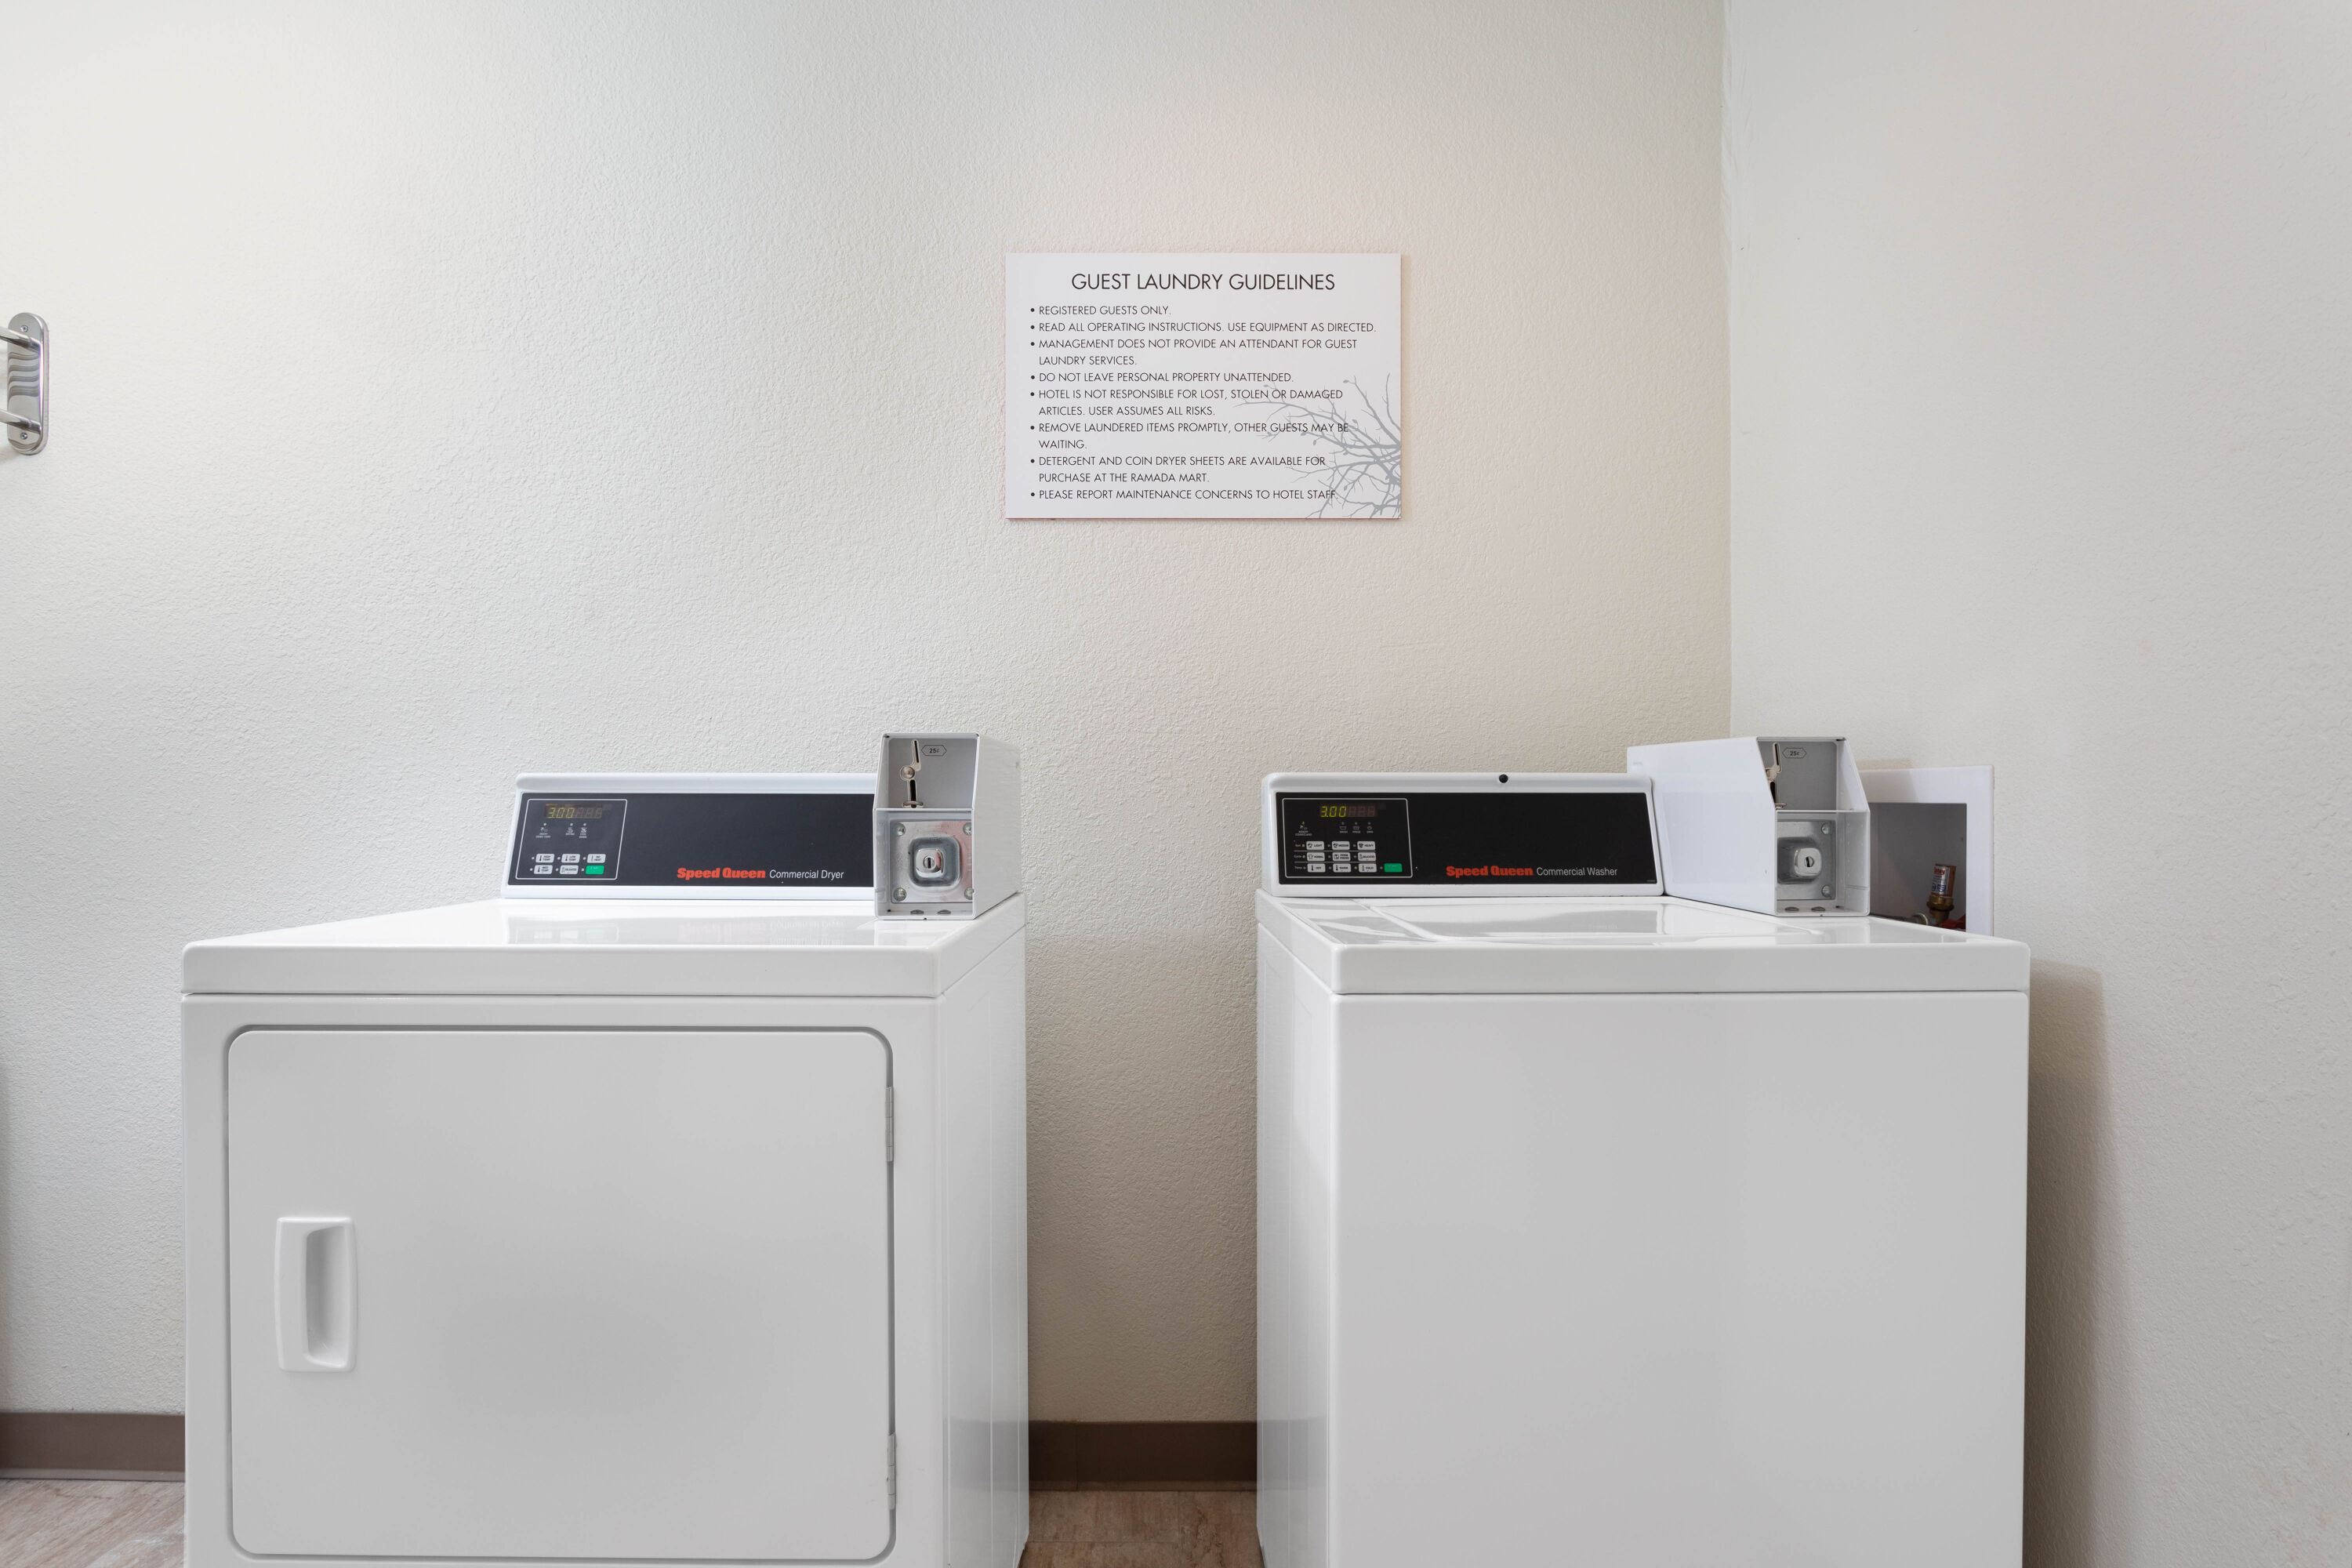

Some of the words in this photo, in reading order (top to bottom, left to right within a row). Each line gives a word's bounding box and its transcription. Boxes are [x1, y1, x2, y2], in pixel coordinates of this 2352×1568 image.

[1072, 274, 1131, 289] GUEST
[1137, 274, 1222, 289] LAUNDRY
[1229, 274, 1334, 290] GUIDELINES
[1040, 306, 1096, 314] REGISTERED
[1100, 306, 1138, 314] GUESTS
[1141, 306, 1171, 314] ONLY.
[1040, 322, 1065, 332] READ
[1069, 322, 1083, 332] ALL
[1088, 322, 1145, 332] OPERATING
[1149, 322, 1223, 332] INSTRUCTIONS.
[1229, 322, 1246, 332] USE
[1250, 322, 1307, 332] EQUIPMENT
[1311, 322, 1324, 332] AS
[1328, 322, 1376, 332] DIRECTED.
[1040, 339, 1114, 348] MANAGEMENT
[1118, 339, 1145, 348] DOES
[1149, 339, 1171, 348] NOT
[1174, 339, 1215, 348] PROVIDE
[1220, 339, 1235, 348] AN
[1240, 339, 1297, 348] ATTENDANT
[1303, 339, 1321, 348] FOR
[1325, 339, 1356, 348] GUEST
[1040, 356, 1085, 365] LAUNDRY
[1090, 356, 1137, 365] SERVICES.
[1040, 373, 1055, 382] DO
[1059, 373, 1080, 382] NOT
[1085, 373, 1113, 382] LEAVE
[1118, 373, 1168, 382] PERSONAL
[1173, 373, 1220, 382] PROPERTY
[1225, 373, 1294, 382] UNATTENDED.
[1040, 390, 1069, 398] HOTEL
[1073, 390, 1080, 398] IS
[1085, 390, 1106, 398] NOT
[1111, 390, 1173, 398] RESPONSIBLE
[1178, 390, 1196, 398] FOR
[1201, 390, 1228, 400] LOST,
[1232, 390, 1268, 398] STOLEN
[1272, 390, 1286, 398] OR
[1290, 390, 1342, 398] DAMAGED
[1039, 406, 1084, 415] ARTICLES.
[1089, 406, 1112, 415] USER
[1116, 406, 1163, 415] ASSUMES
[1167, 406, 1182, 415] ALL
[1187, 406, 1215, 415] RISKS.
[1040, 423, 1080, 432] REMOVE
[1085, 423, 1143, 432] LAUNDERED
[1147, 423, 1174, 432] ITEMS
[1178, 423, 1231, 434] PROMPTLY,
[1235, 423, 1266, 432] OTHER
[1271, 423, 1308, 432] GUESTS
[1312, 423, 1334, 432] MAY
[1338, 423, 1348, 432] BE
[1039, 440, 1087, 448] WAITING.
[1040, 456, 1095, 465] DETERGENT
[1099, 456, 1122, 465] AND
[1126, 456, 1152, 465] COIN
[1156, 456, 1185, 465] DRYER
[1190, 456, 1224, 465] SHEETS
[1229, 456, 1246, 465] ARE
[1250, 456, 1301, 465] AVAILABLE
[1306, 456, 1325, 465] FOR
[1040, 474, 1090, 482] PURCHASE
[1094, 474, 1106, 482] AT
[1110, 474, 1127, 482] THE
[1131, 474, 1175, 482] RAMADA
[1179, 474, 1210, 482] MART.
[1040, 490, 1073, 499] PLEASE
[1077, 490, 1112, 499] REPORT
[1116, 490, 1191, 499] MAINTENANCE
[1196, 490, 1252, 499] CONCERNS
[1257, 490, 1269, 499] TO
[1273, 490, 1304, 499] HOTEL
[1308, 490, 1338, 499] STAFF.
[677, 867, 720, 880] Speed
[722, 867, 766, 878] Queen
[769, 869, 818, 879] Commercial
[821, 869, 844, 880] Dryer
[1446, 866, 1488, 878] Speed
[1490, 866, 1534, 876] Queen
[1537, 867, 1584, 876] Commercial
[1587, 867, 1617, 876] Washer
